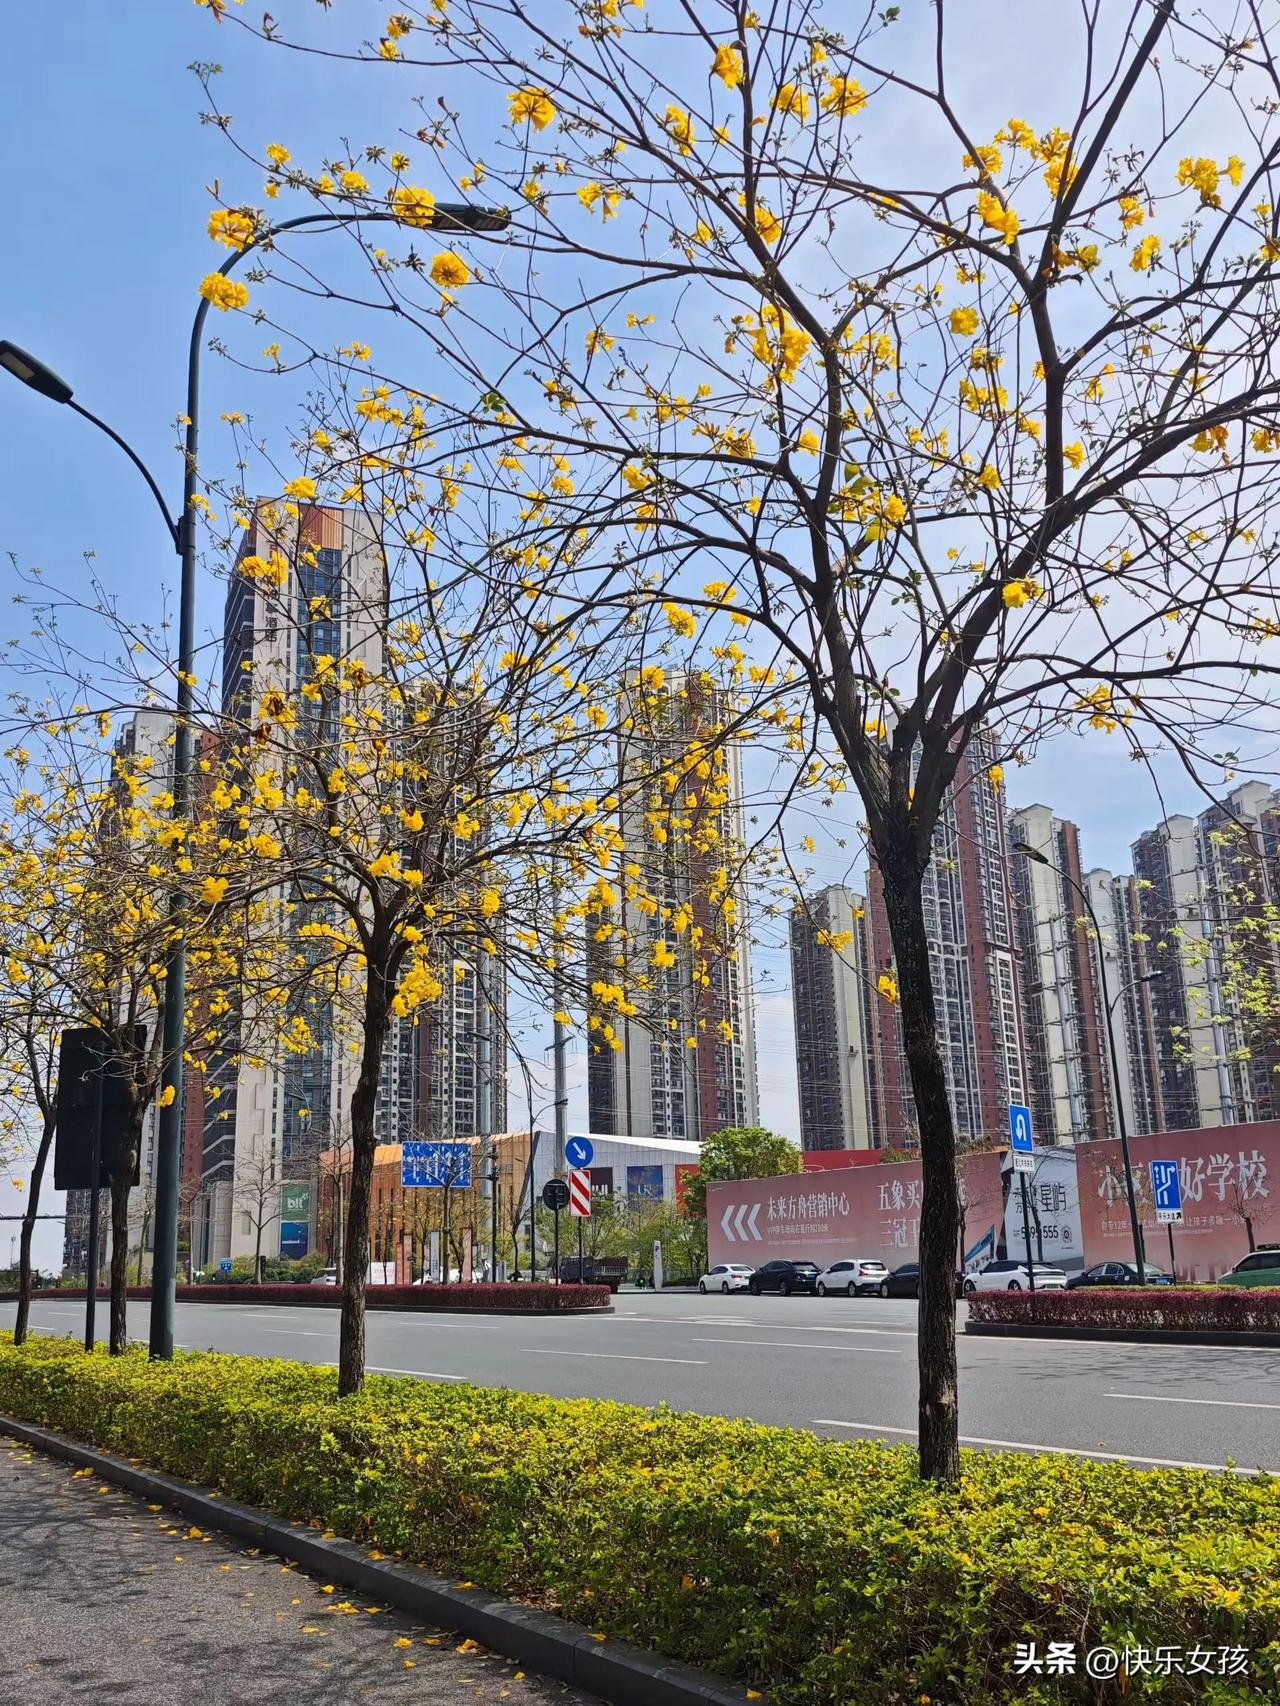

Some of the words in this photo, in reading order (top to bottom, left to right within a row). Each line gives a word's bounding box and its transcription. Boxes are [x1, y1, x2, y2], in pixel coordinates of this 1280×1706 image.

[767, 1191, 850, 1220] 未来方舟营销中心
